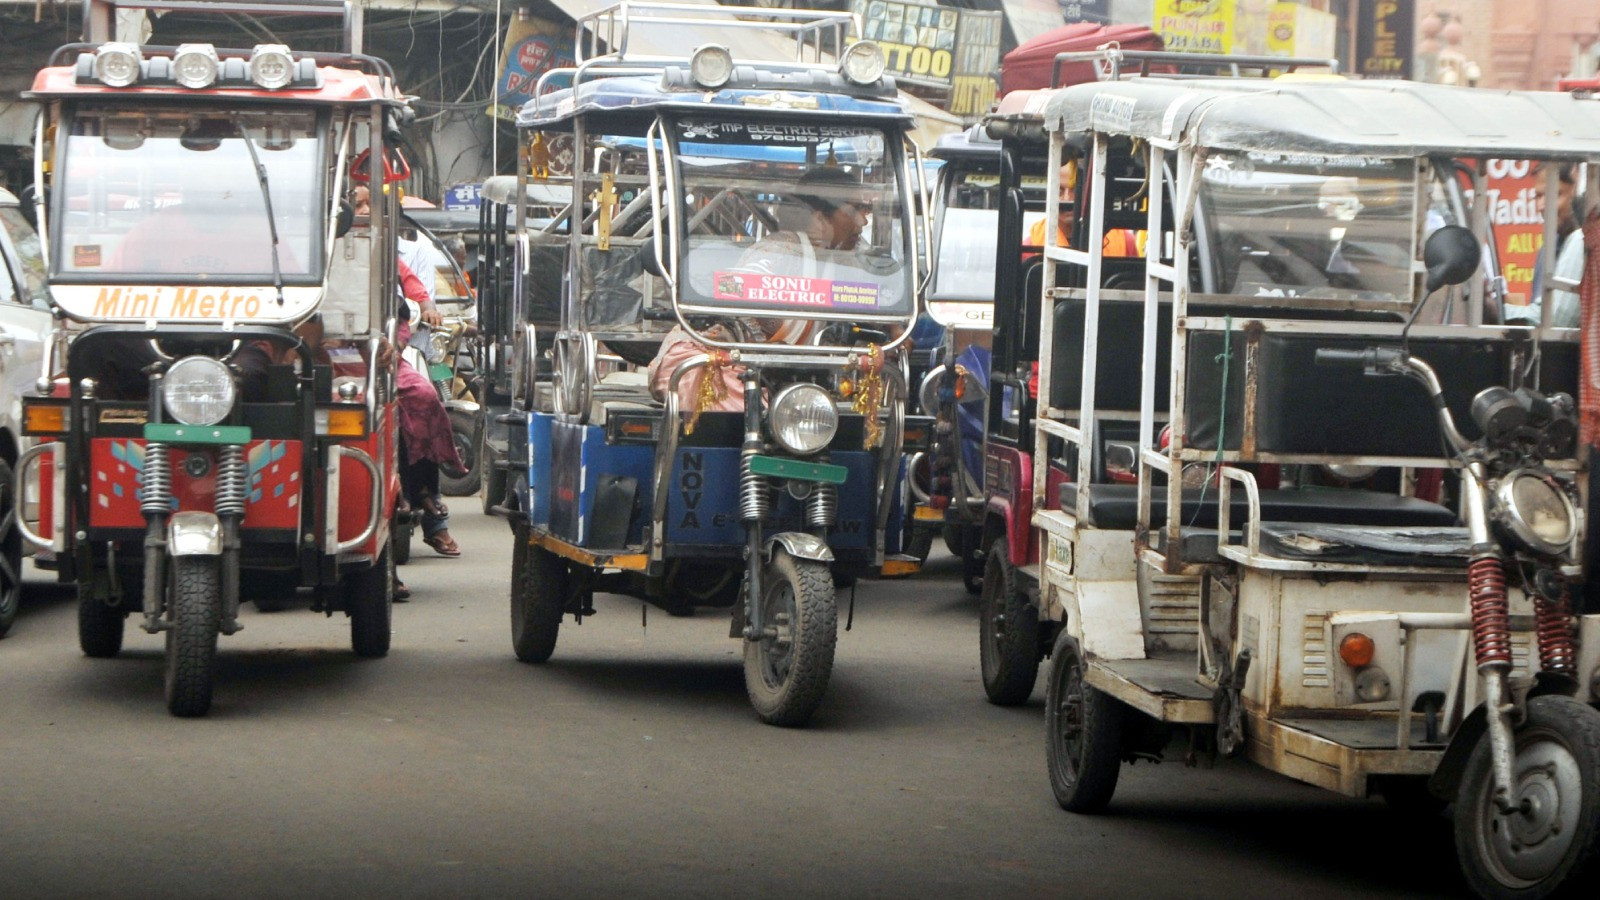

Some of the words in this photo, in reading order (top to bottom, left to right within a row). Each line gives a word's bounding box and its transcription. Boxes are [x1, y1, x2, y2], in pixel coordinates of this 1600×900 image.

[845, 37, 951, 77] TTOO
[721, 123, 743, 132] MP
[747, 124, 818, 136] ELECTRIC
[1465, 188, 1544, 225] adi
[1507, 233, 1534, 253] All
[748, 288, 826, 304] ELECTRIC
[762, 276, 811, 292] SONU
[93, 287, 162, 317] Mini
[170, 287, 260, 317] Metro
[682, 453, 703, 528] NOVA
